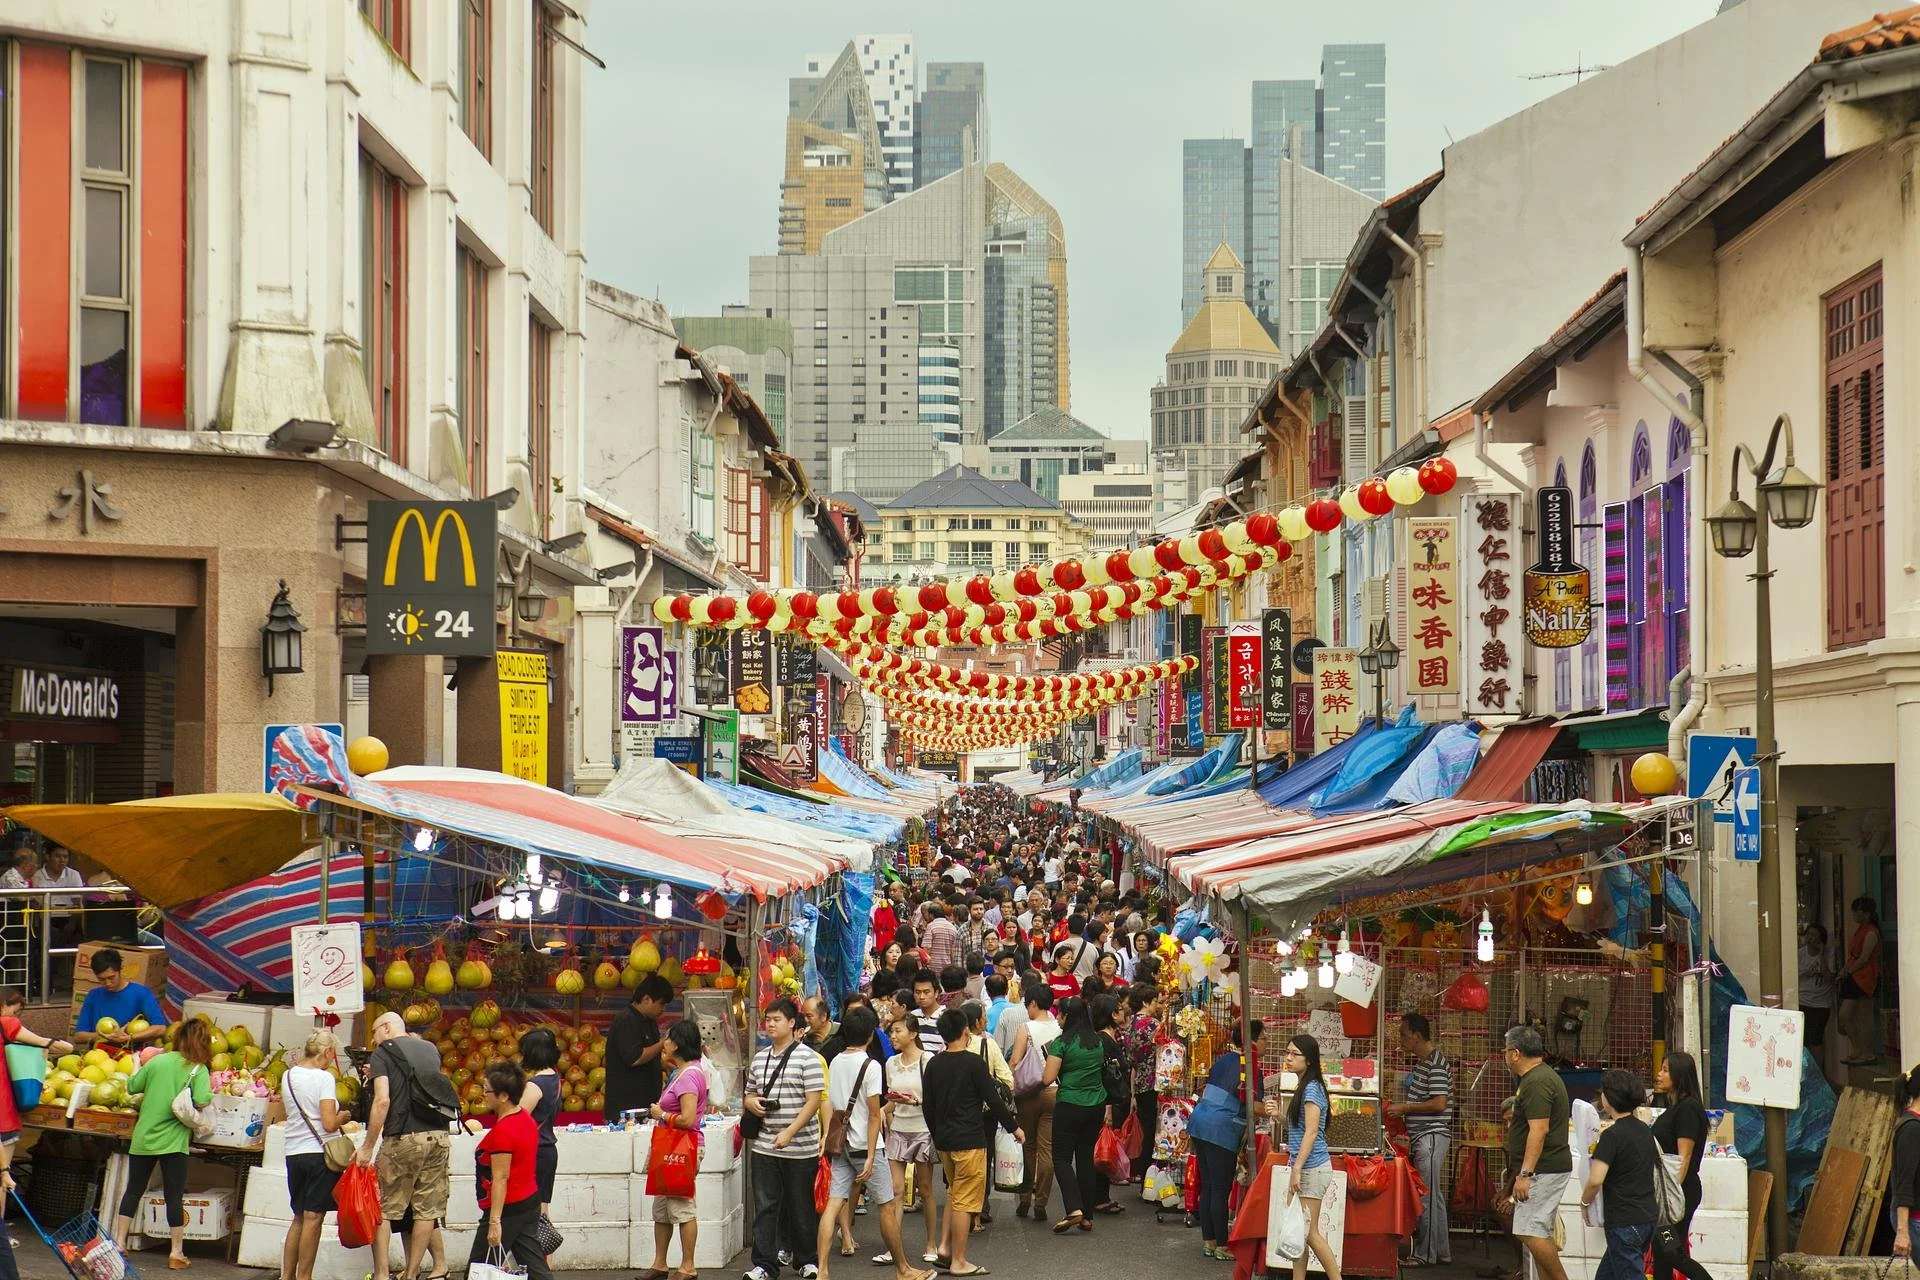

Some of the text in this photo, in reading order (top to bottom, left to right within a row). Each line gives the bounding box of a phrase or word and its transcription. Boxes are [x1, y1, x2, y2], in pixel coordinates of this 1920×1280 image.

[1548, 493, 1562, 572] 62238387
[434, 610, 474, 638] 24
[498, 654, 546, 678] ROAD CLOSURE
[20, 669, 118, 719] McDonald's
[510, 714, 532, 734] TEMPLE
[1737, 834, 1758, 851] ONE WAY
[1762, 911, 1769, 928] 1
[321, 947, 355, 987] 2
